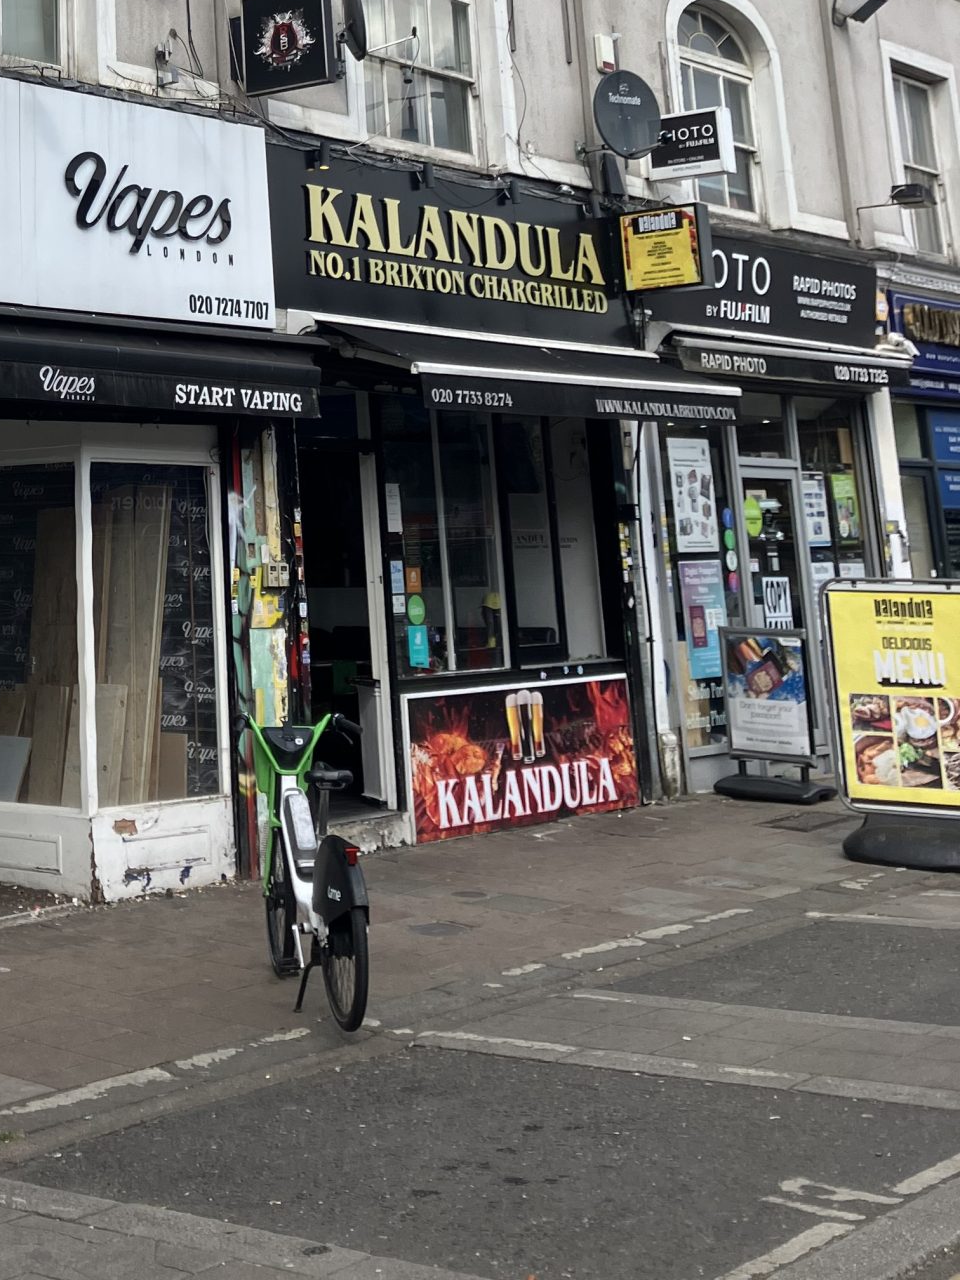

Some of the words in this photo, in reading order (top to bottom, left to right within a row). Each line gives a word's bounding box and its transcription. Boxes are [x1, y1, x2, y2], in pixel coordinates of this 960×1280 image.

[608, 92, 642, 106] Technomate
[64, 151, 233, 256] Vapes
[304, 183, 606, 286] KALANDULA
[146, 243, 235, 267] LONDON
[309, 250, 362, 282] NO.1
[368, 258, 466, 296] BRIXTON
[470, 275, 608, 315] CHARGRILLED
[711, 248, 772, 296] OTO
[792, 275, 821, 294] RAPID
[821, 280, 857, 300] PHOTOS
[189, 294, 212, 315] 020
[214, 296, 242, 318] 7274
[242, 299, 269, 321] 7707
[706, 305, 718, 317] BY
[700, 352, 732, 371] RAPID
[734, 355, 767, 374] PHOTO
[39, 365, 96, 399] Vapes
[174, 383, 236, 408] START
[240, 386, 303, 412] VAPING
[431, 387, 453, 404] 020
[456, 389, 483, 406] 7733
[484, 391, 513, 407] 8274
[765, 580, 790, 614] COPY
[881, 636, 933, 651] DELICIOUS
[873, 650, 947, 688] MENU
[436, 757, 619, 830] KALANDULA
